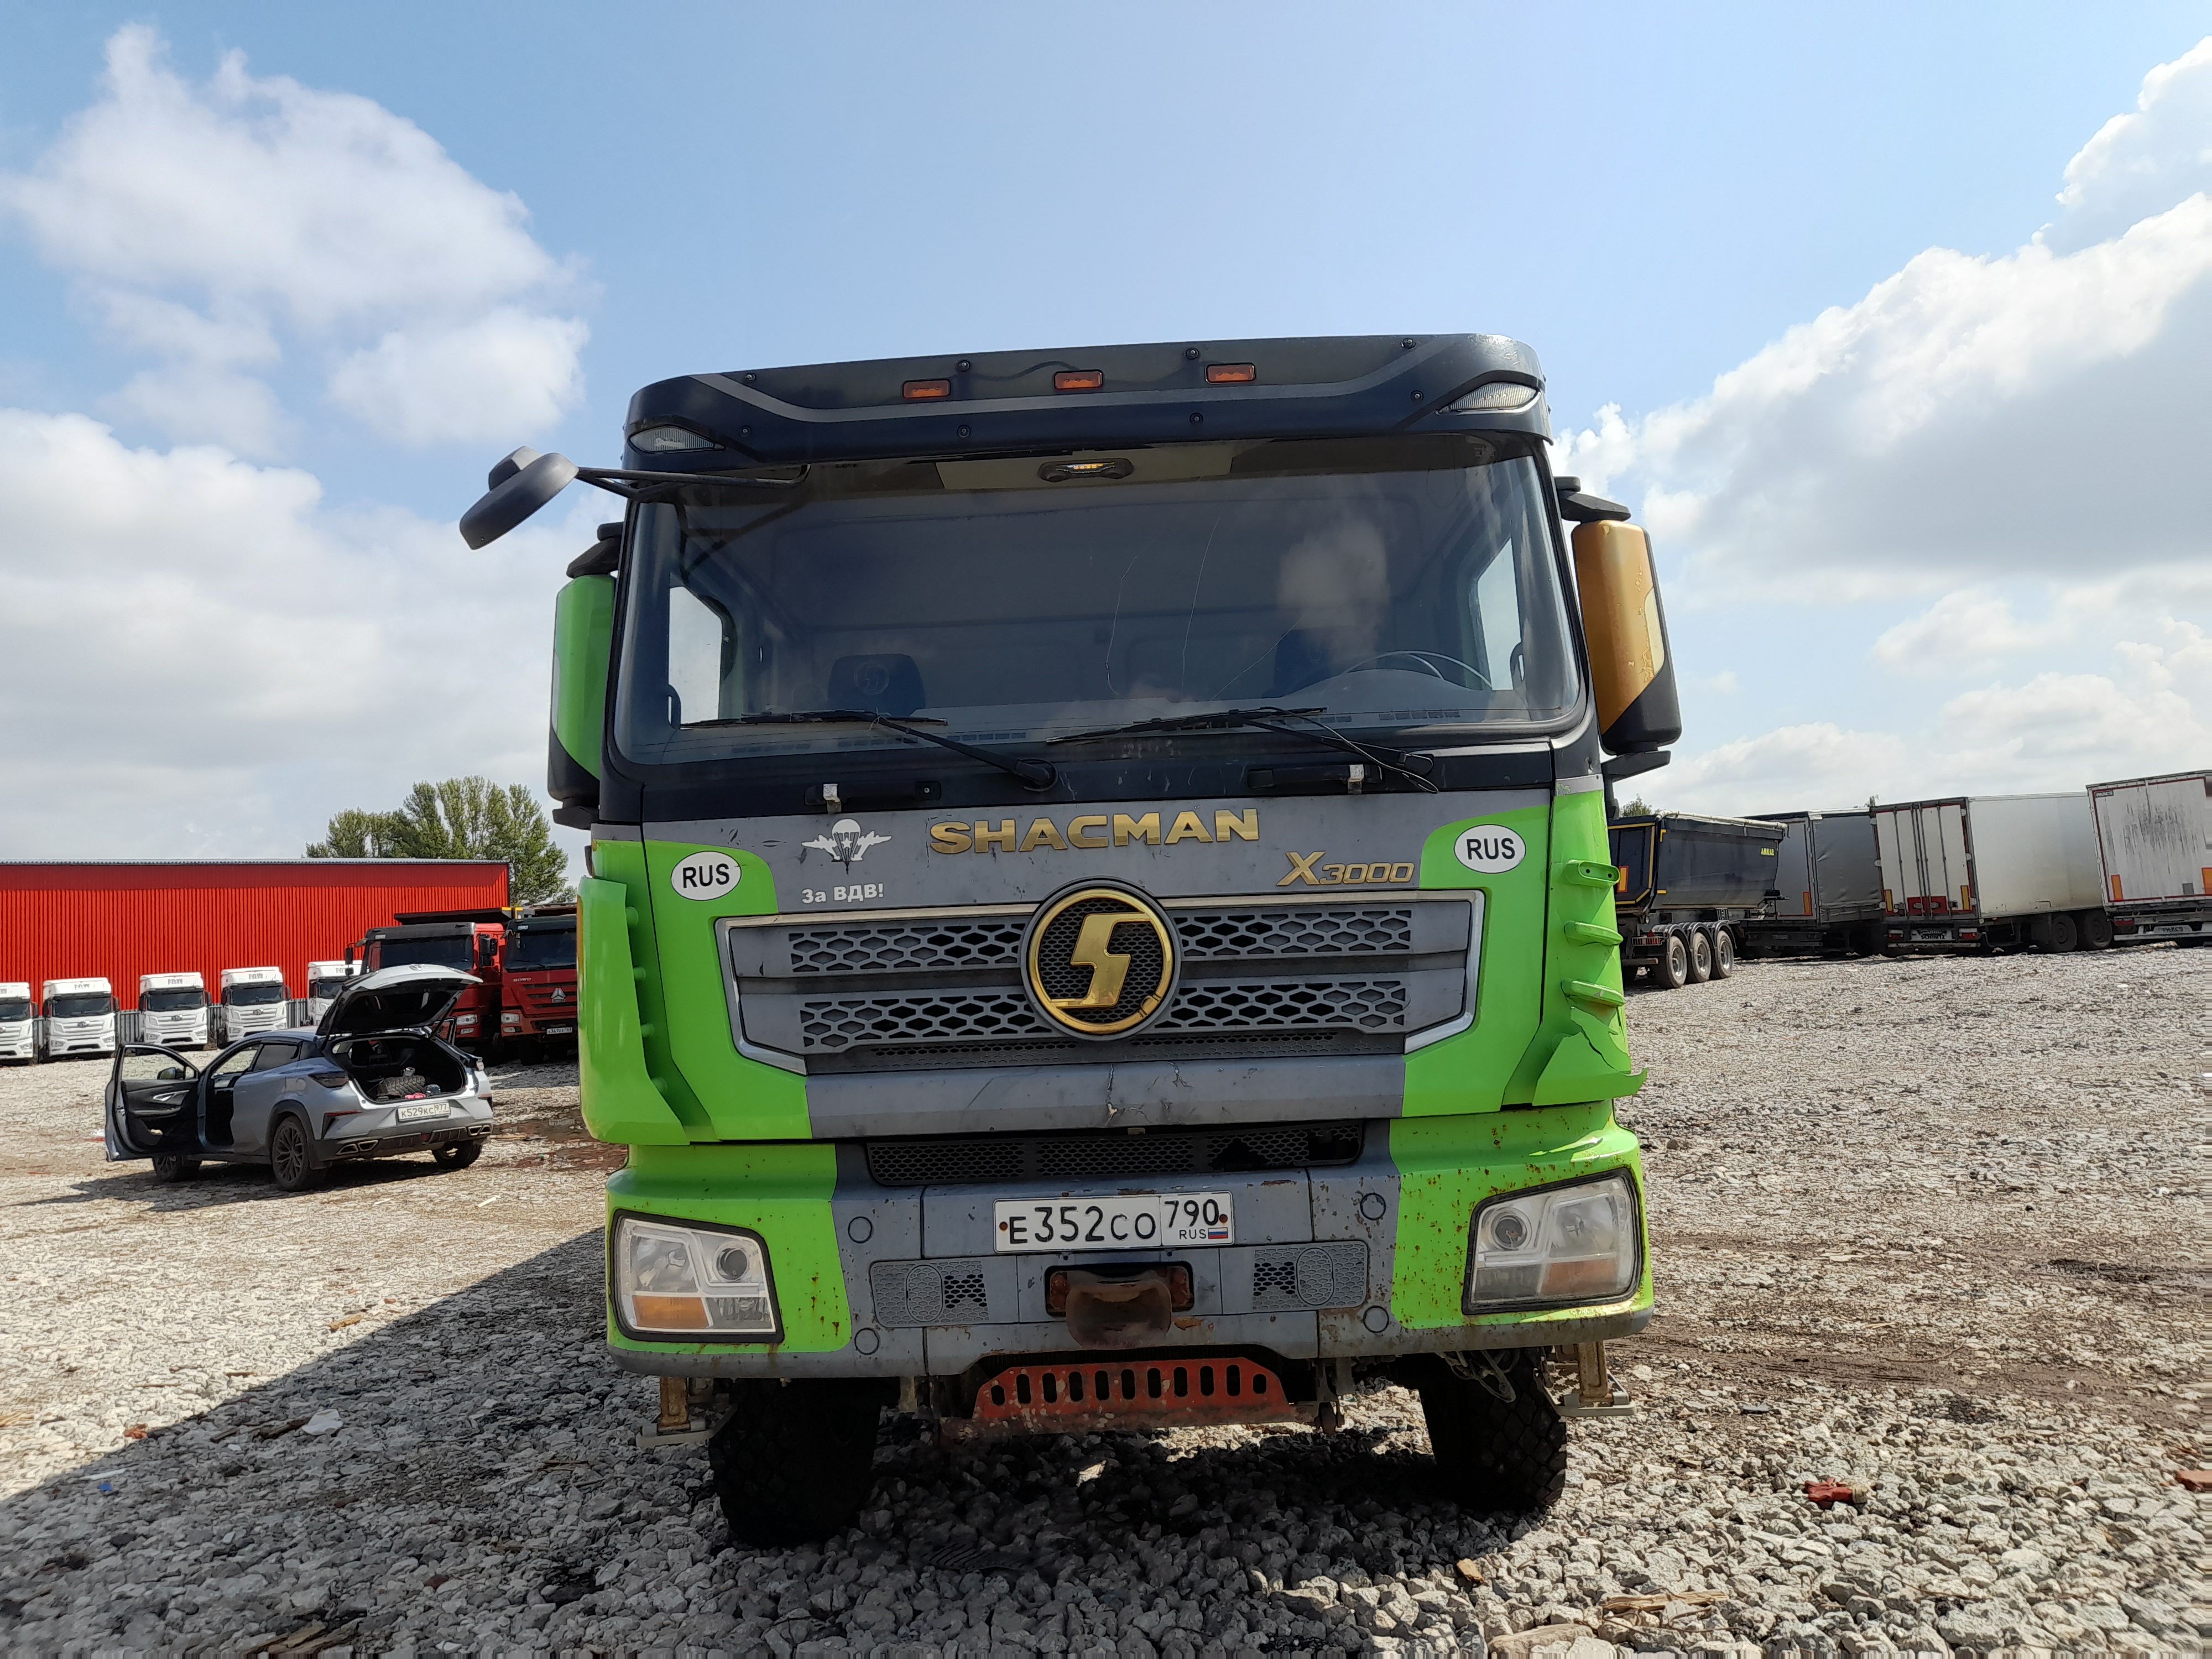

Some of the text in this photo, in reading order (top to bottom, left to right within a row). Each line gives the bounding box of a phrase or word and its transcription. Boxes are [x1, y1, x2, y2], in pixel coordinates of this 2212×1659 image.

[930, 808, 1260, 854] SHACMAN
[1466, 837, 1515, 860] RUS
[682, 863, 730, 889] RUS
[1276, 851, 1415, 886] X3000
[801, 883, 884, 904] За ВДВ!
[1165, 1198, 1219, 1228] 790
[1179, 1228, 1207, 1240] RUS
